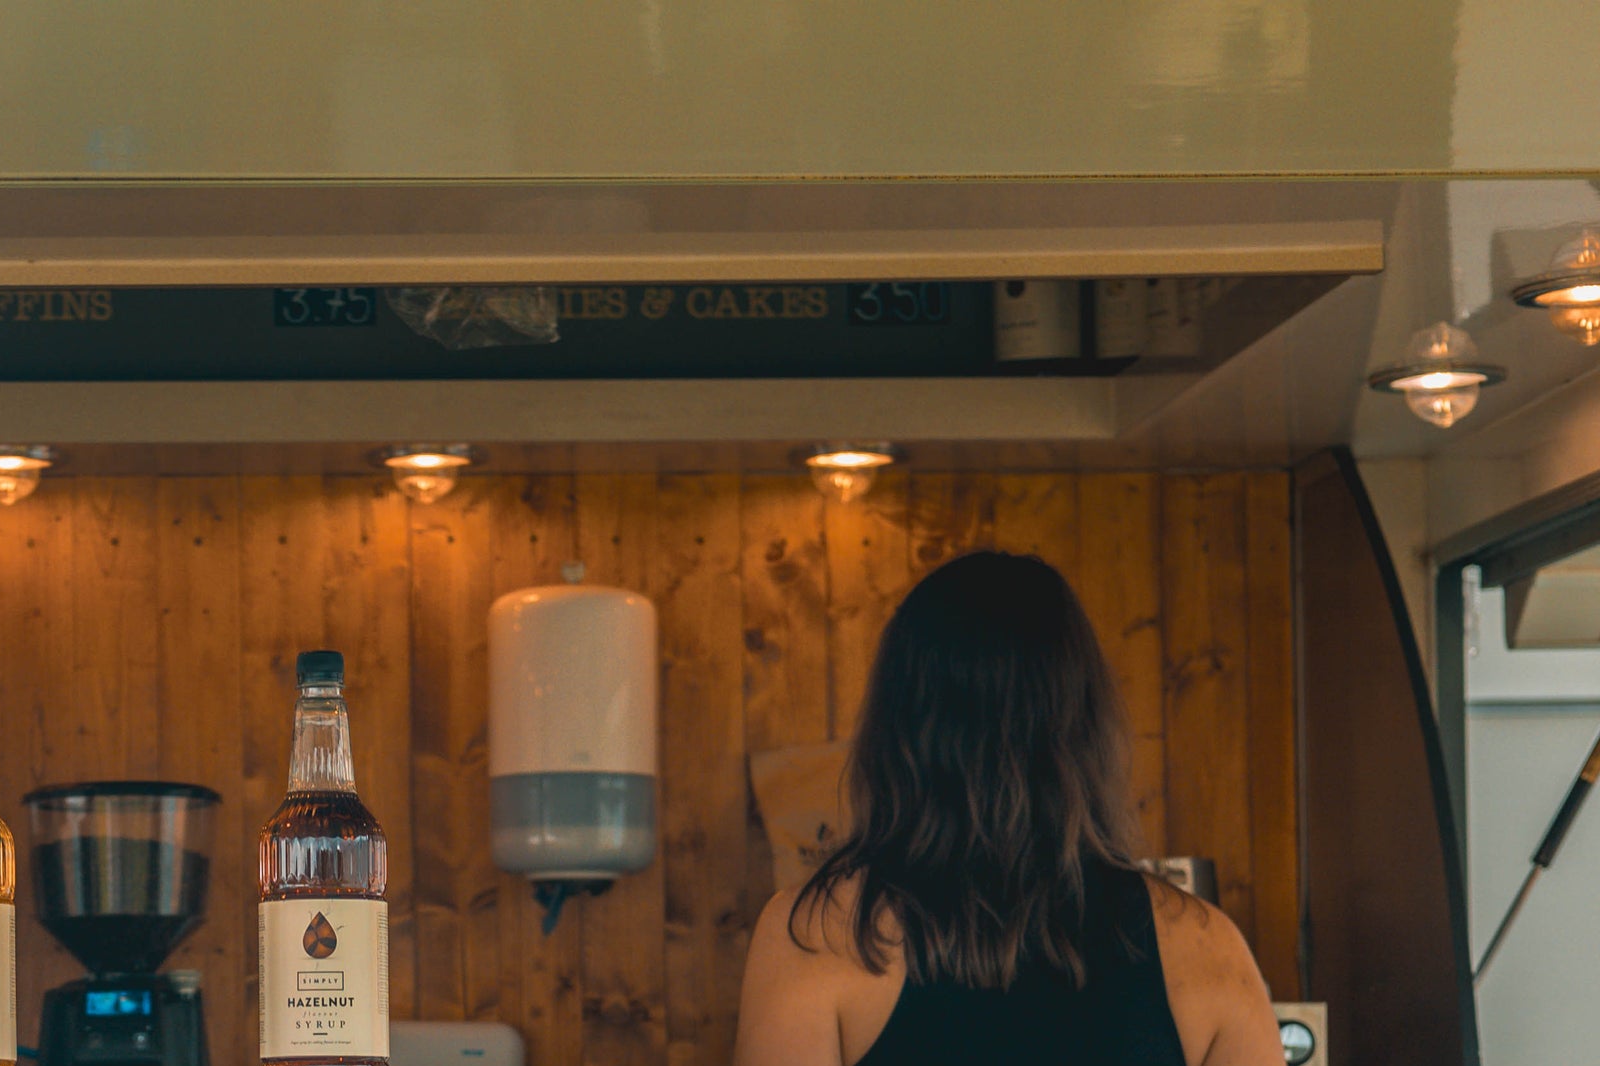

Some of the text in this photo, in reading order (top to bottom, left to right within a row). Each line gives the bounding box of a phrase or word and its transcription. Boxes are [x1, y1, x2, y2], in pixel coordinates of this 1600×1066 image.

[639, 287, 675, 319] &
[686, 286, 828, 320] CAKES
[287, 997, 355, 1008] HAZELNUT
[295, 1020, 347, 1030] SYRUP
